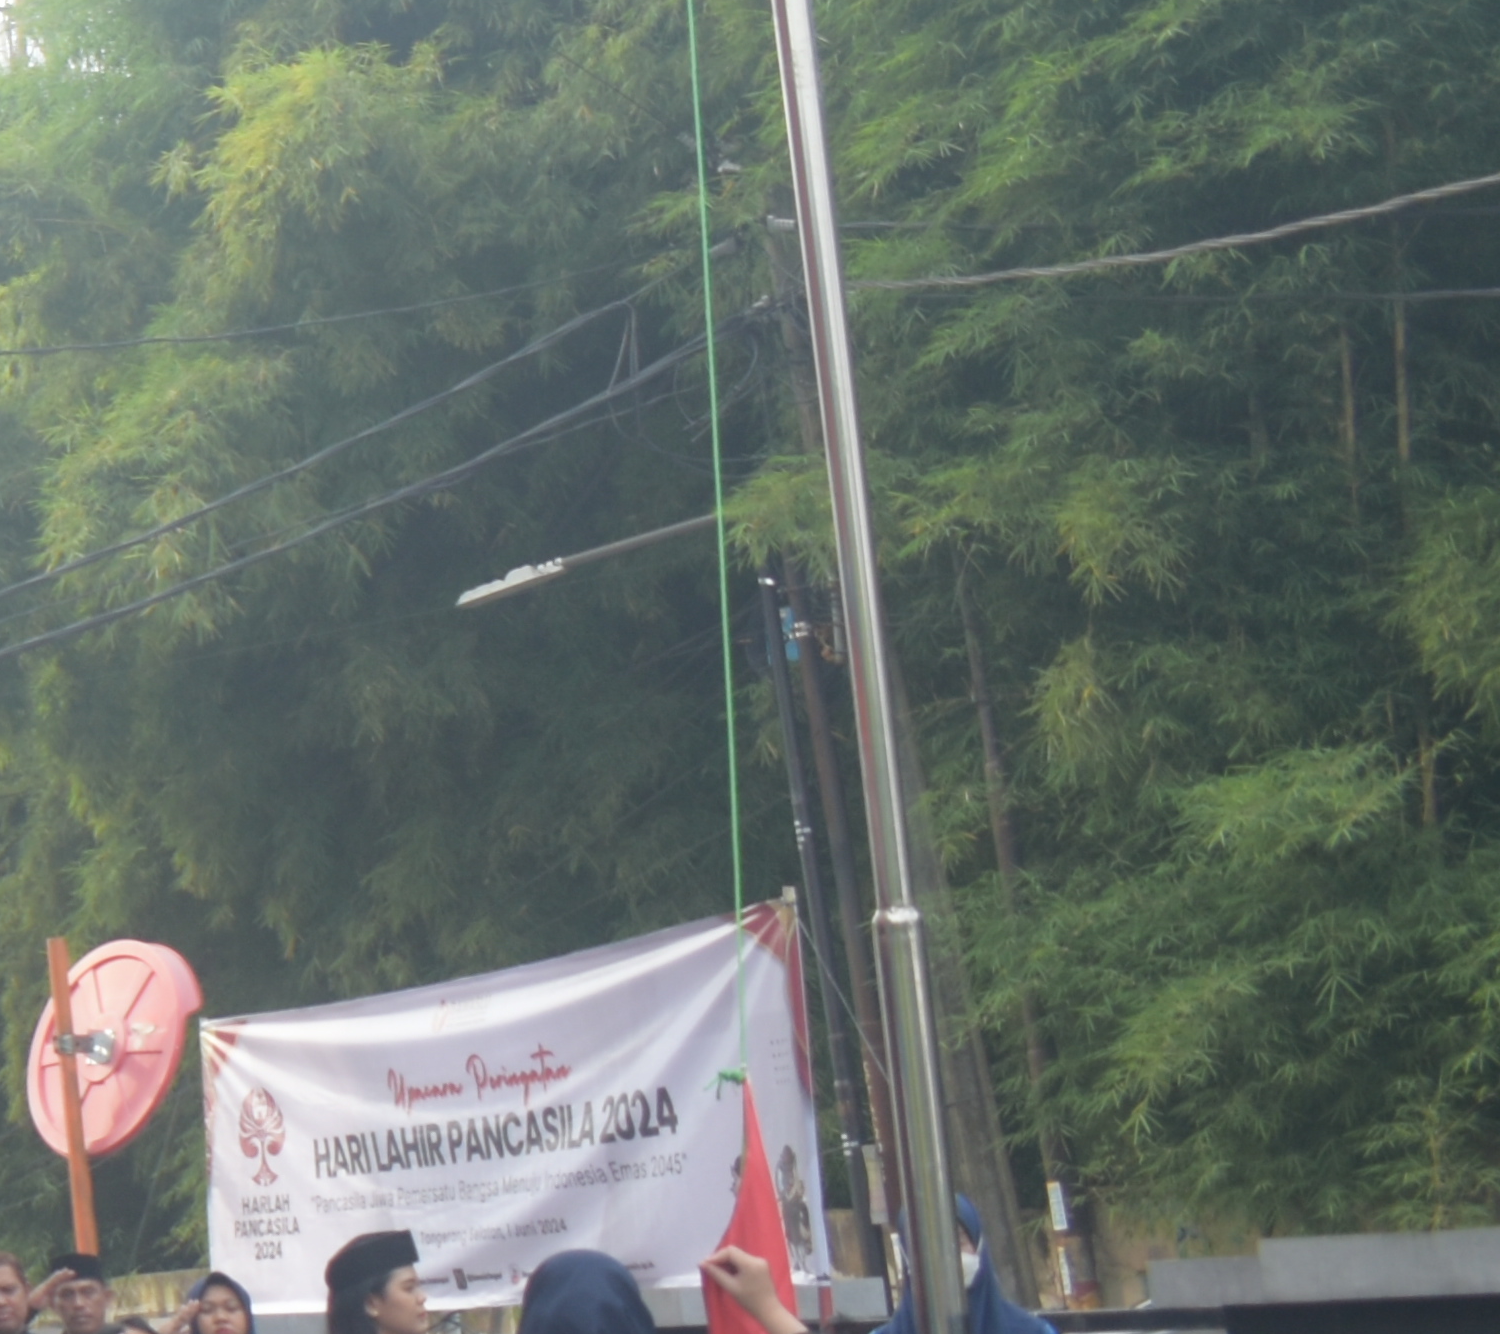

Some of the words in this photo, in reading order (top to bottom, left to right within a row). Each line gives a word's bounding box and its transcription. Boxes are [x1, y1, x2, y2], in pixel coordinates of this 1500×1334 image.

[387, 1068, 463, 1114] Upacara
[314, 1127, 371, 1179] HARI
[373, 1123, 445, 1173] LAHIR
[447, 1101, 595, 1166] PANCASILA
[599, 1086, 678, 1144] 2024
[544, 1165, 607, 1190] Indonesia
[610, 1160, 648, 1182] Emas
[242, 1194, 290, 1215] HARLAH
[234, 1216, 300, 1238] PANCASILA
[514, 1221, 537, 1237] Juni
[539, 1218, 568, 1234] 2024
[255, 1242, 282, 1260] 2024
